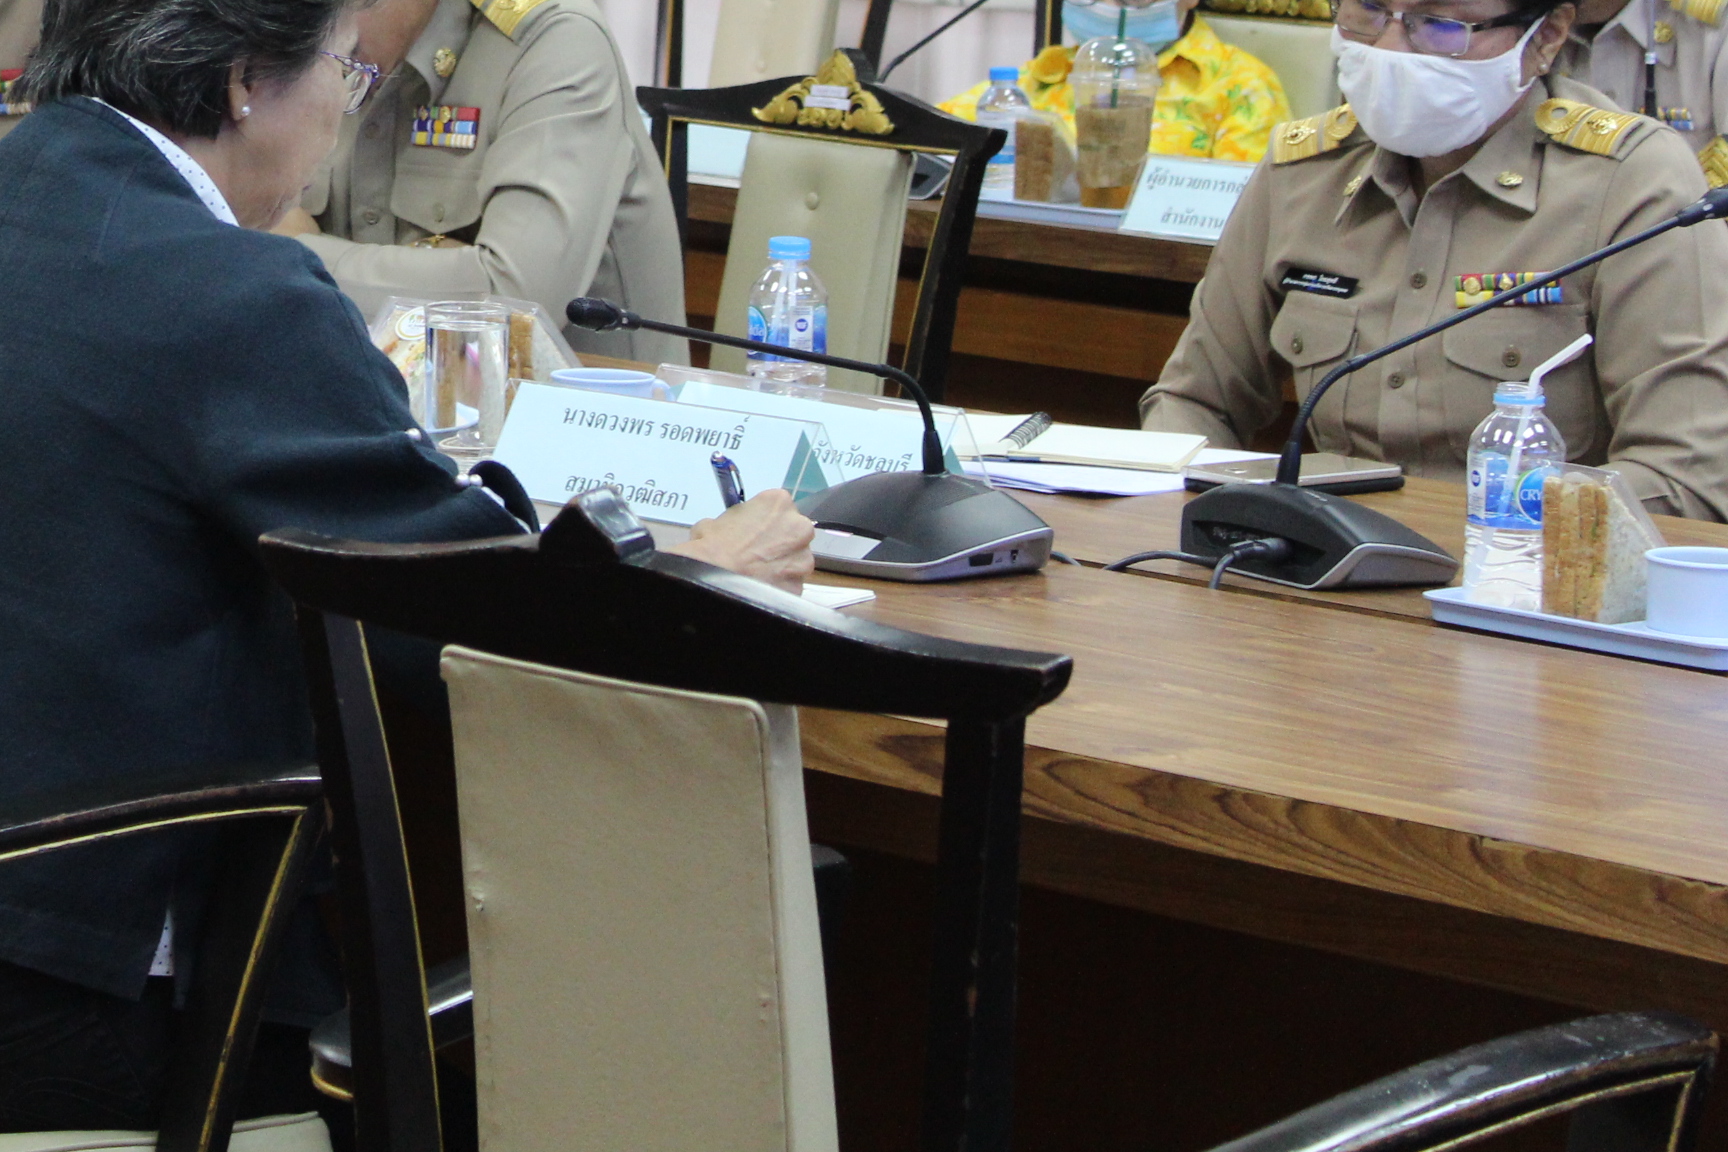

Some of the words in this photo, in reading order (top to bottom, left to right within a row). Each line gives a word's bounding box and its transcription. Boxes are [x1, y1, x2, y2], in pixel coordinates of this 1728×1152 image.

[562, 407, 656, 437] นางดวงพร
[659, 414, 751, 451] รอดพยาธิ์
